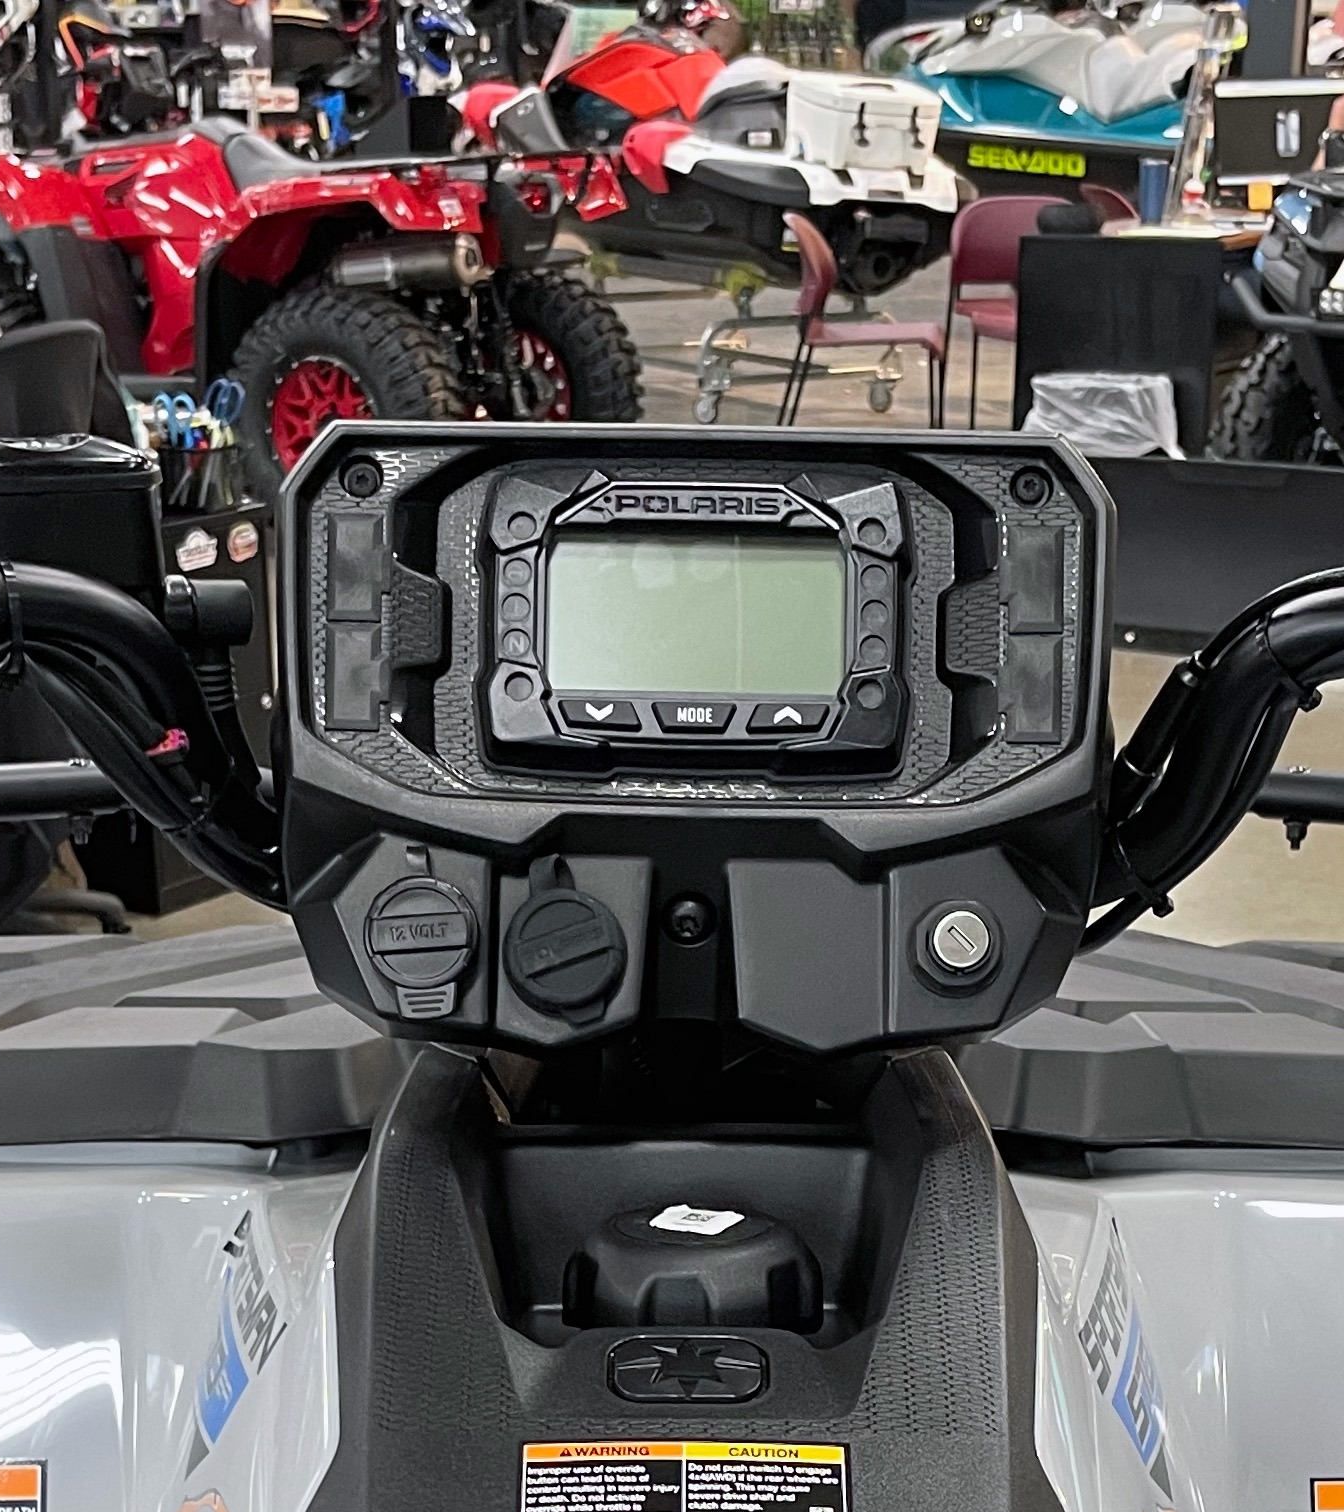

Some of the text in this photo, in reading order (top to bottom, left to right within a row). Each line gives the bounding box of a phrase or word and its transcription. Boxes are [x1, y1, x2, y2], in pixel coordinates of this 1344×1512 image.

[614, 496, 779, 515] POLARIS
[509, 636, 524, 652] N
[677, 707, 713, 723] MODE
[409, 922, 449, 940] VOLT
[575, 1446, 650, 1458] WARNING
[729, 1447, 799, 1459] CAUTION
